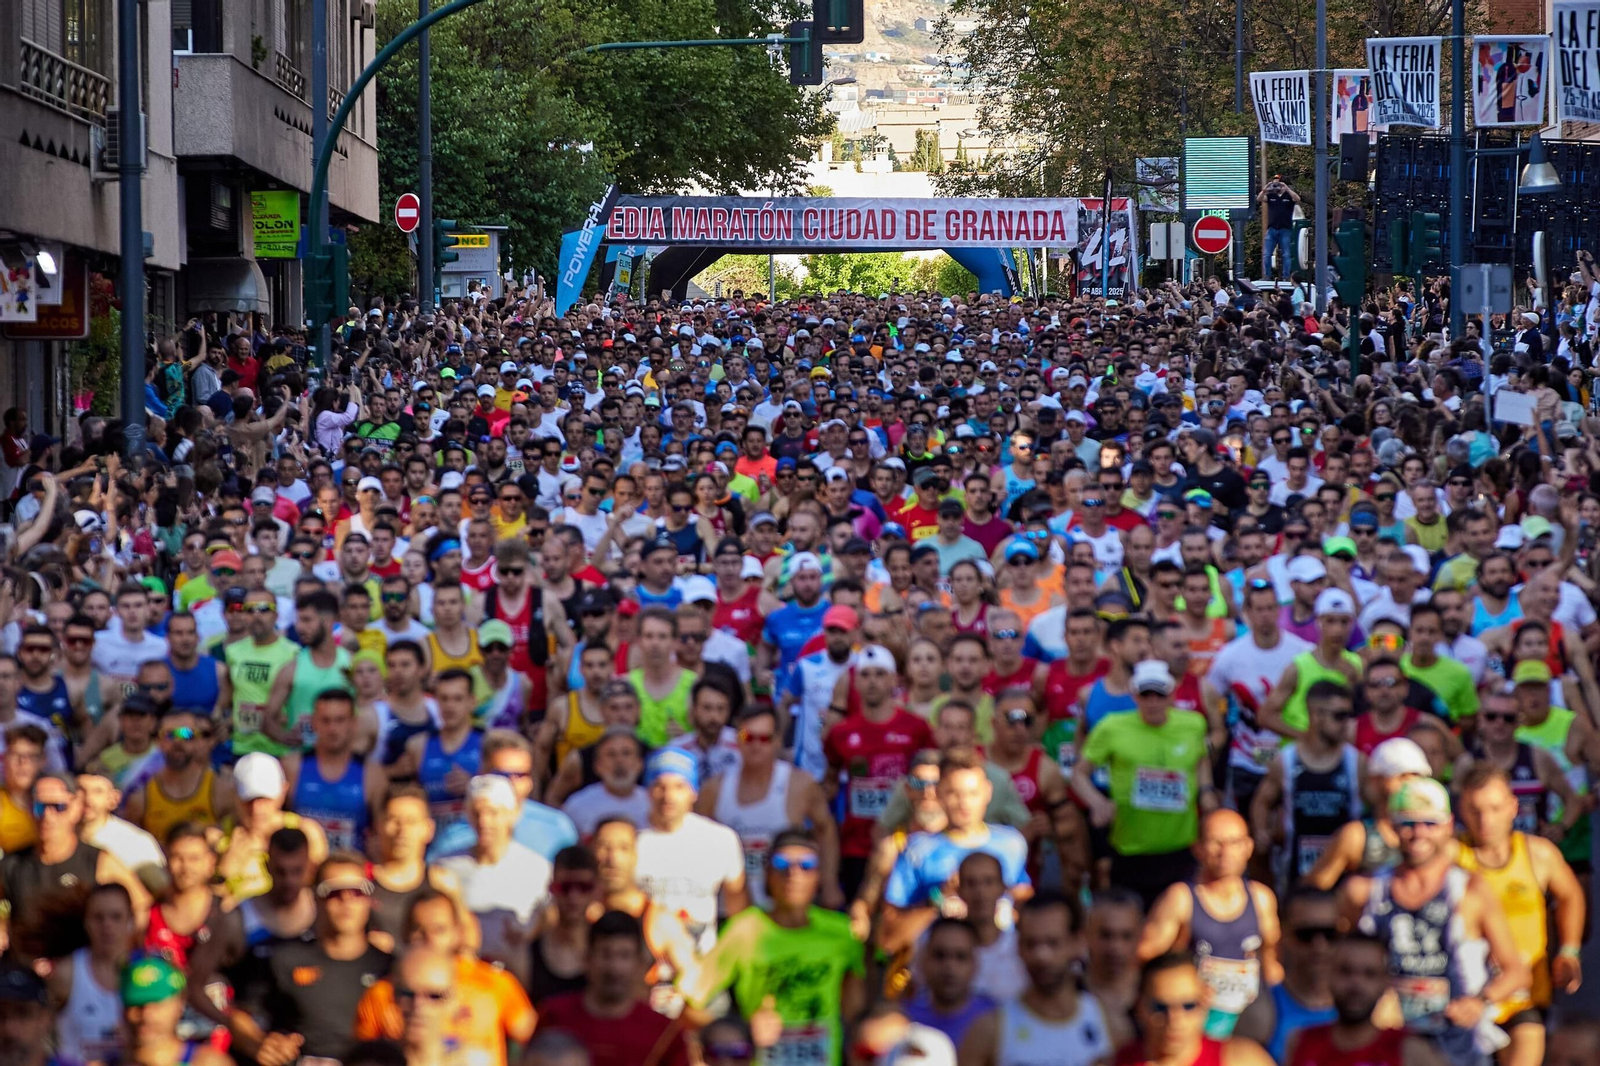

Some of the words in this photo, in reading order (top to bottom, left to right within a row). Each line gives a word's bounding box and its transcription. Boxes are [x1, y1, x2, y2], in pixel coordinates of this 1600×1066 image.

[1558, 10, 1580, 48] LA
[1586, 9, 1600, 48] F
[1371, 46, 1388, 72] LA
[1394, 44, 1435, 72] FERIA
[1560, 49, 1591, 91] DEL
[1254, 79, 1268, 102] LA
[1271, 76, 1306, 101] FERIA
[1374, 70, 1402, 101] DEL
[1400, 72, 1435, 103] VINO
[1257, 101, 1279, 125] DEL
[1278, 100, 1307, 125] VINO
[253, 220, 294, 230] OLON
[606, 206, 667, 240] EDIA
[672, 202, 794, 241] MARATÓN
[802, 208, 897, 241] CIUDAD
[905, 208, 937, 241] DE
[945, 208, 1067, 241] GRANADA
[460, 236, 486, 246] NCE
